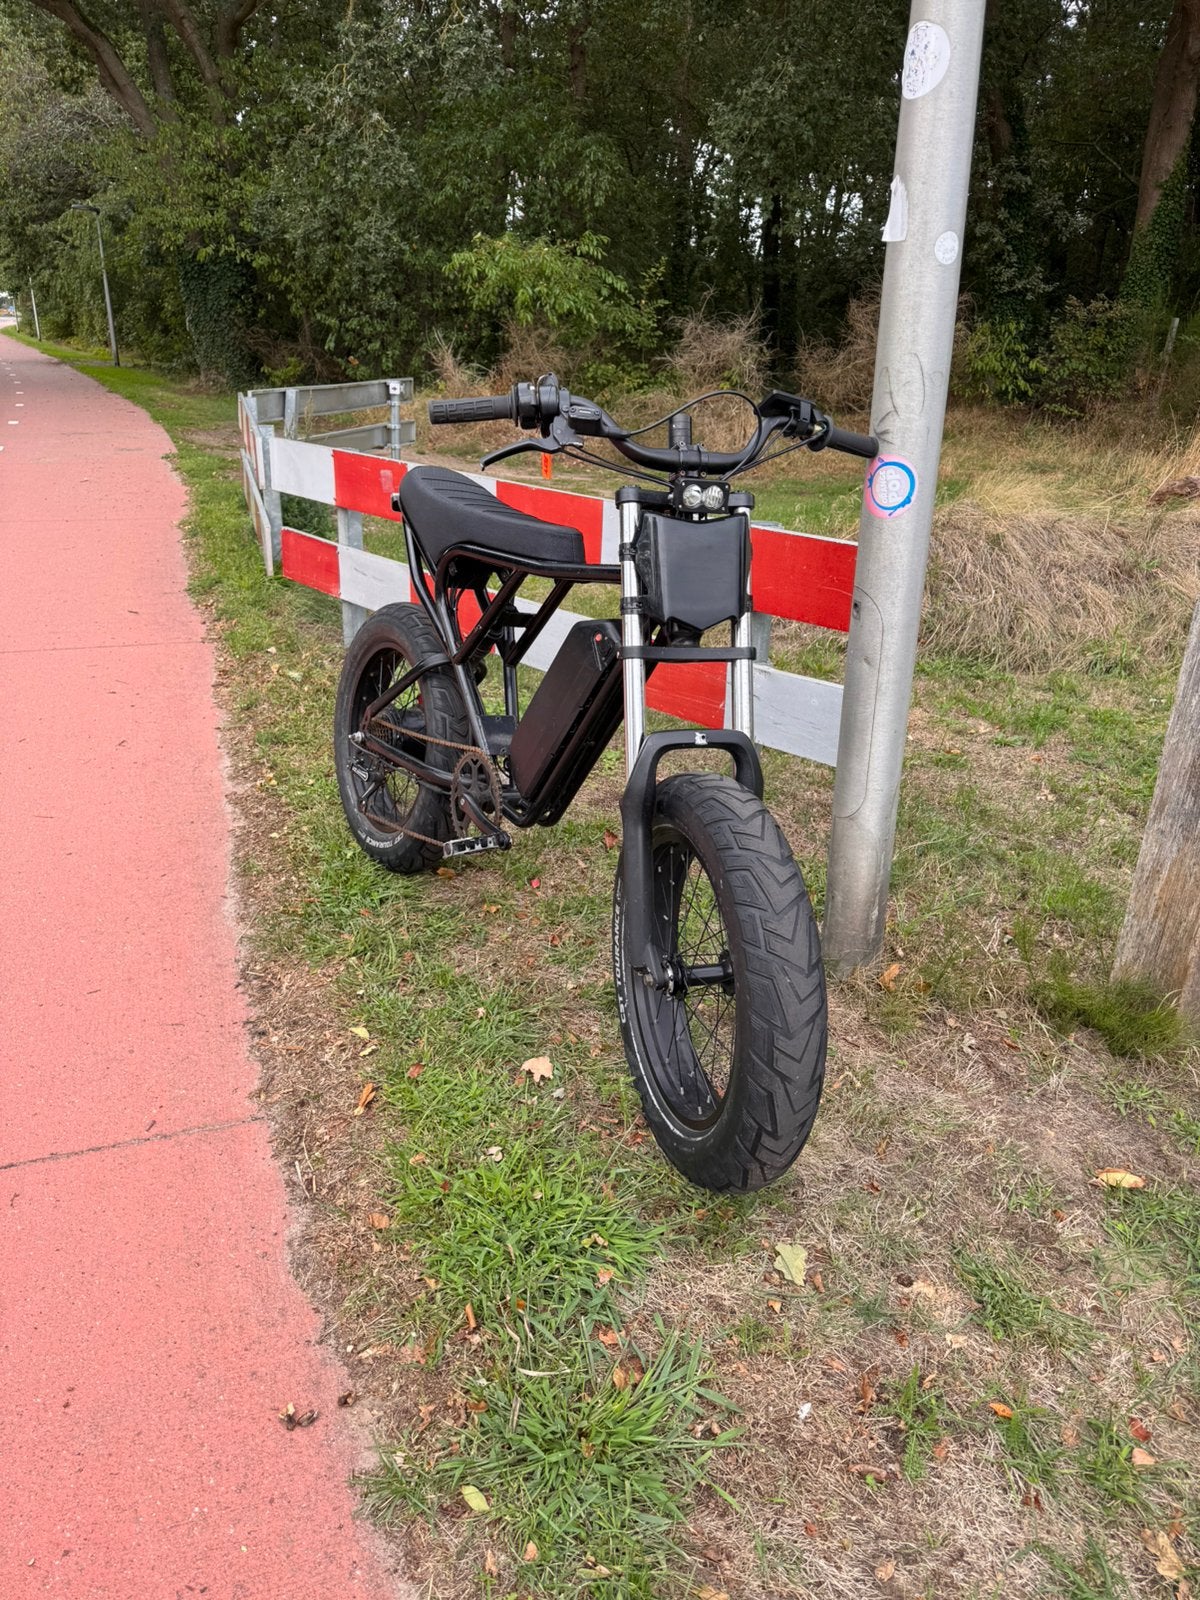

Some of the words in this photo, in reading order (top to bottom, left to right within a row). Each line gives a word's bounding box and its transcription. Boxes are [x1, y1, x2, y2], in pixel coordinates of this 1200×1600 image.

[365, 836, 393, 848] TOURANCE
[614, 904, 622, 986] TOURANCE
[618, 994, 626, 1023] CST
